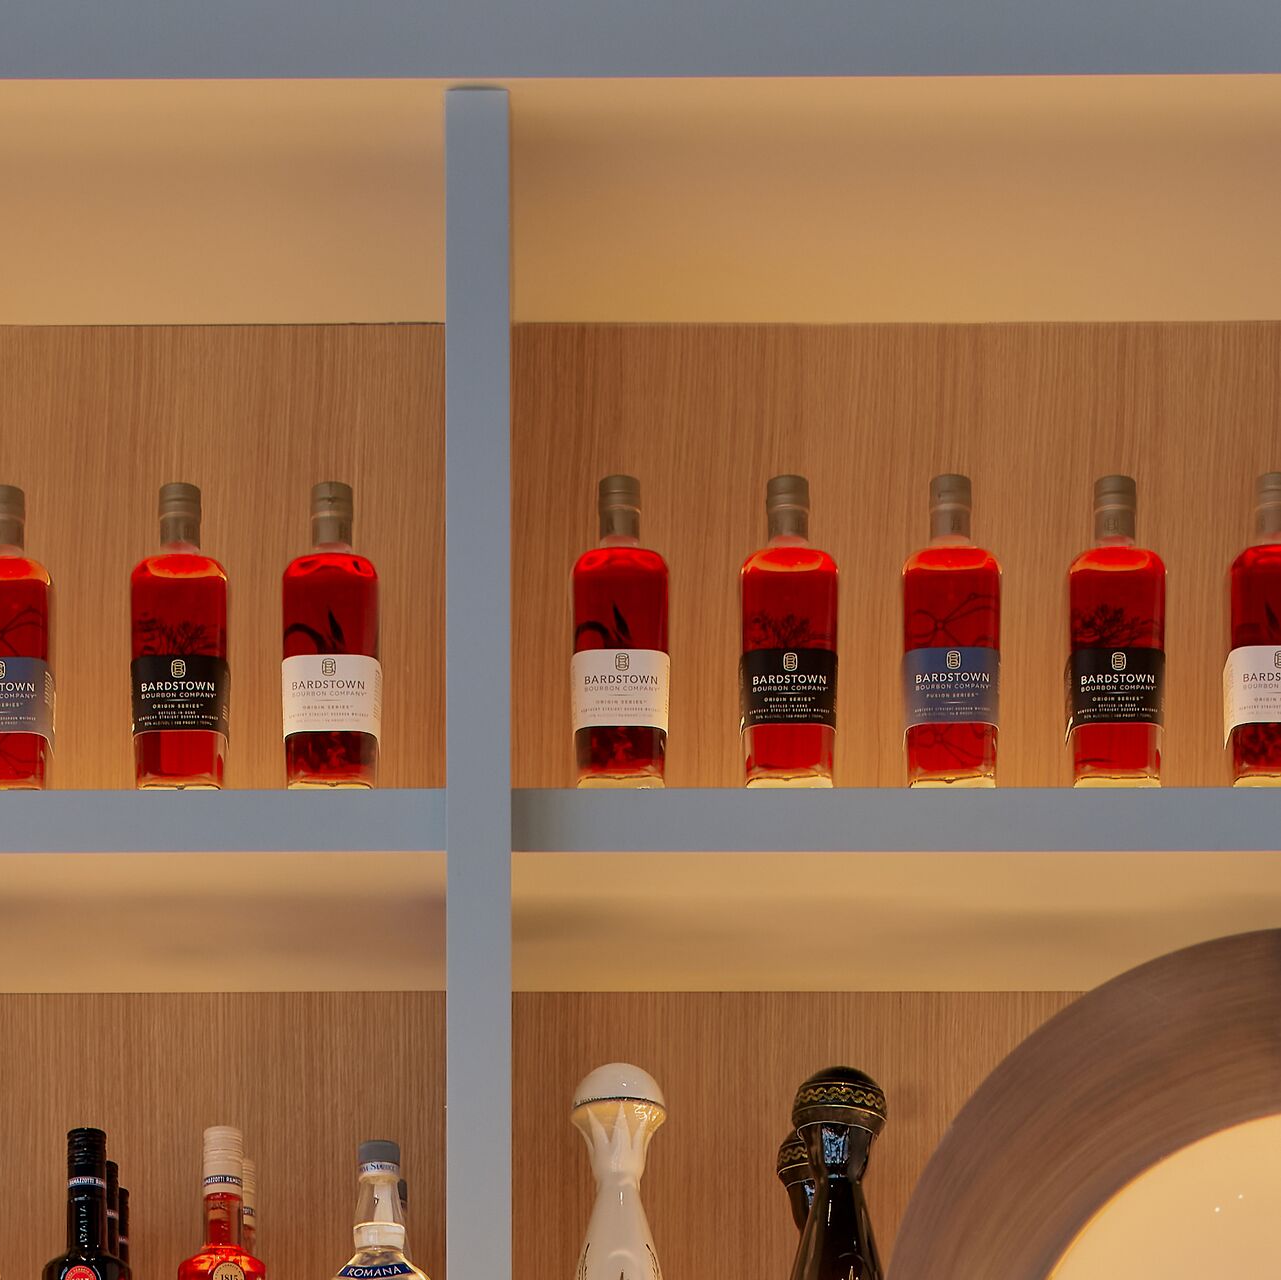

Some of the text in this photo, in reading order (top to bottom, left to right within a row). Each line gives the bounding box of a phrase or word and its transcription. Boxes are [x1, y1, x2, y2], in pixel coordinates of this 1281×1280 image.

[584, 674, 658, 685] BARDSTOWN
[752, 674, 827, 685] BARDSTOWN
[915, 672, 990, 683] BARDSTOWN
[1081, 674, 1155, 685] BARDSTOWN
[141, 681, 215, 692] BARDSTOWN
[291, 680, 365, 691] BARDSTOWN
[347, 1265, 402, 1278] ROMANA
